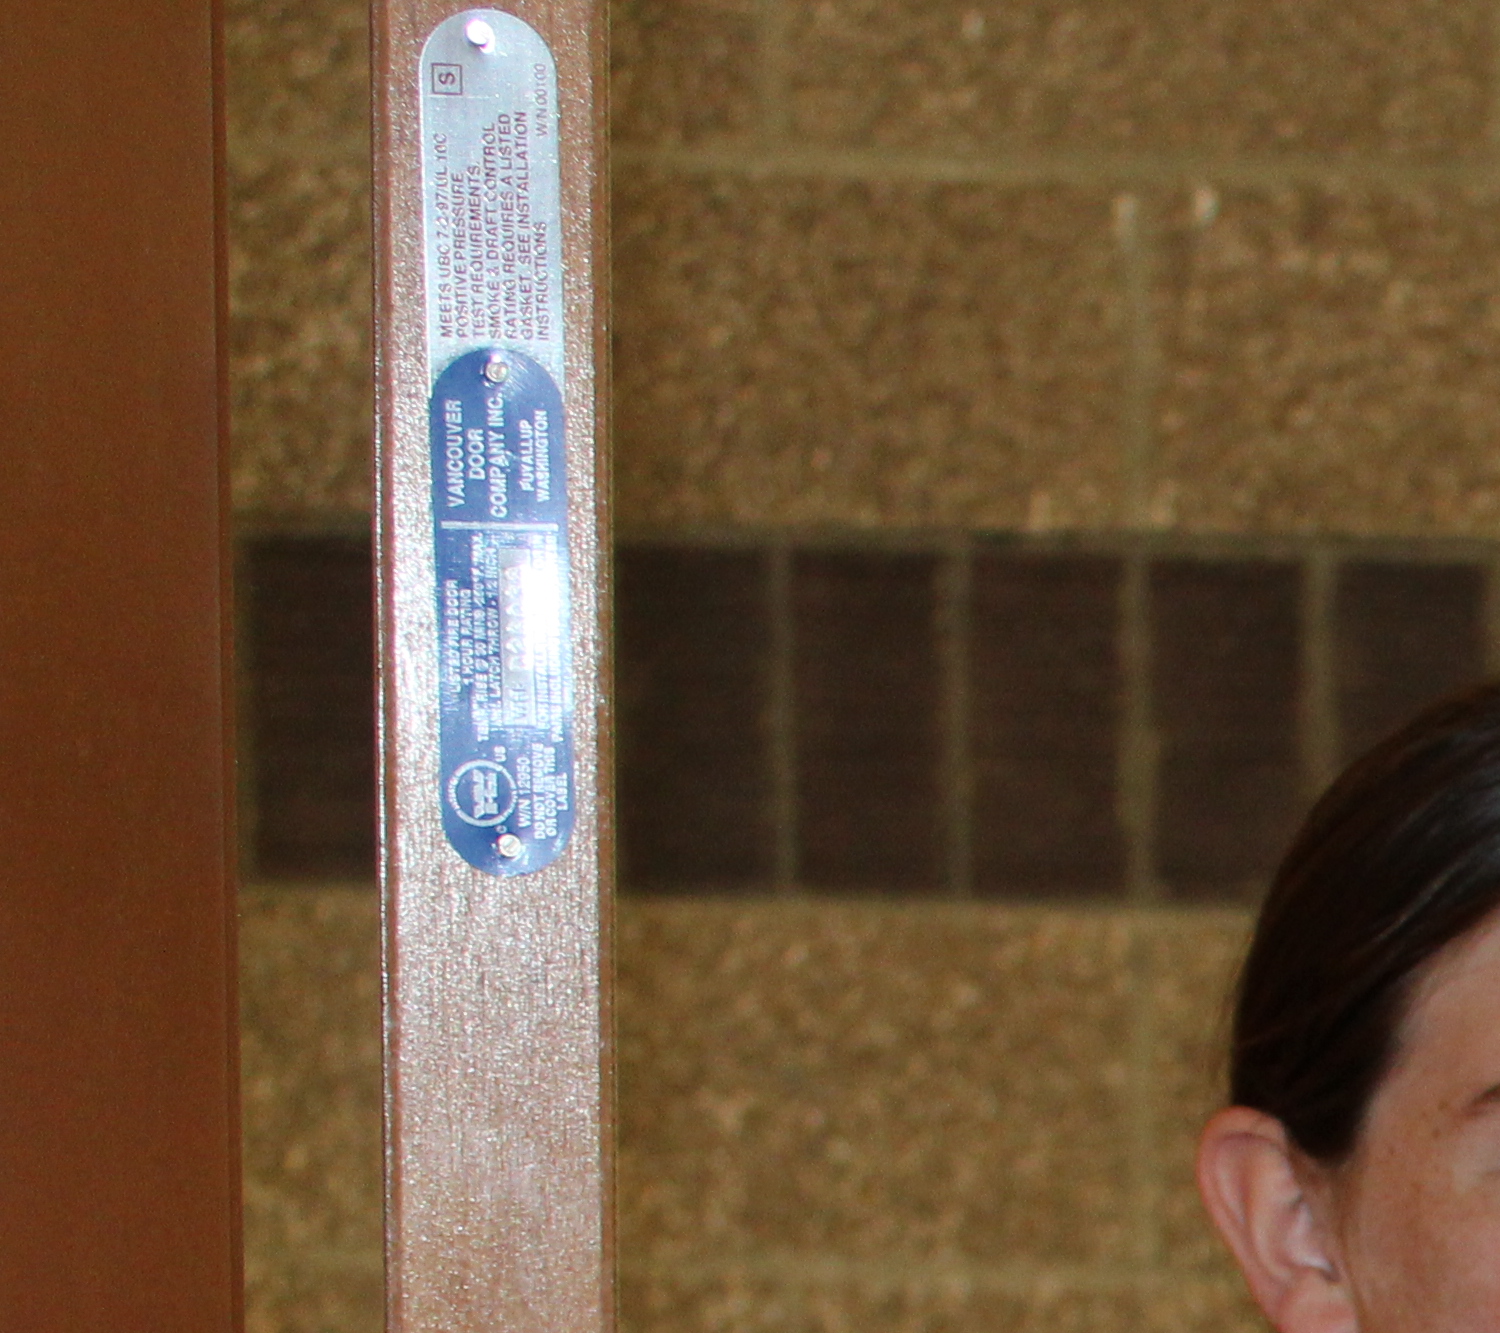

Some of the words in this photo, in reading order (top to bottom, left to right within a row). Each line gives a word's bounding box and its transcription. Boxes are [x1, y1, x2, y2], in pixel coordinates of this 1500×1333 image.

[438, 72, 455, 85] S
[433, 133, 448, 161] 10C
[482, 121, 498, 203] CONTROL
[498, 113, 512, 170] LISTED
[500, 175, 513, 186] A
[514, 111, 530, 229] INSTALLATION
[451, 173, 467, 260] PRESSURE
[485, 208, 499, 260] DRAFT
[500, 191, 514, 274] REQUIRES
[437, 244, 451, 278] UBC
[517, 234, 531, 266] SEE
[454, 265, 469, 338] POSITIVE
[532, 222, 549, 341] INSTRUCTIONS
[439, 283, 453, 338] MEETS
[471, 299, 485, 337] TEST
[487, 281, 501, 339] SMOKE
[502, 280, 517, 339] RATING
[486, 393, 505, 427] INC.
[445, 399, 465, 507] VANCOUVER
[467, 428, 486, 480] DOOR
[487, 430, 508, 518] COMPANY
[519, 419, 535, 491] PUYALLUP
[533, 409, 550, 502] WASHINGTON
[445, 579, 459, 616] DOOR
[460, 588, 473, 636] RATING
[486, 607, 500, 655] THROW
[461, 638, 474, 675] HOUR
[488, 656, 501, 698] LATCH
[493, 745, 506, 762] US
[516, 756, 531, 795] 12950
[531, 743, 545, 793] REMOVE
[543, 746, 556, 774] THIS
[517, 799, 531, 828] W/N
[533, 794, 546, 820] NOT
[544, 775, 557, 817] COVER
[556, 771, 569, 811] LABEL
[533, 820, 546, 840] DO
[545, 818, 557, 837] OR
